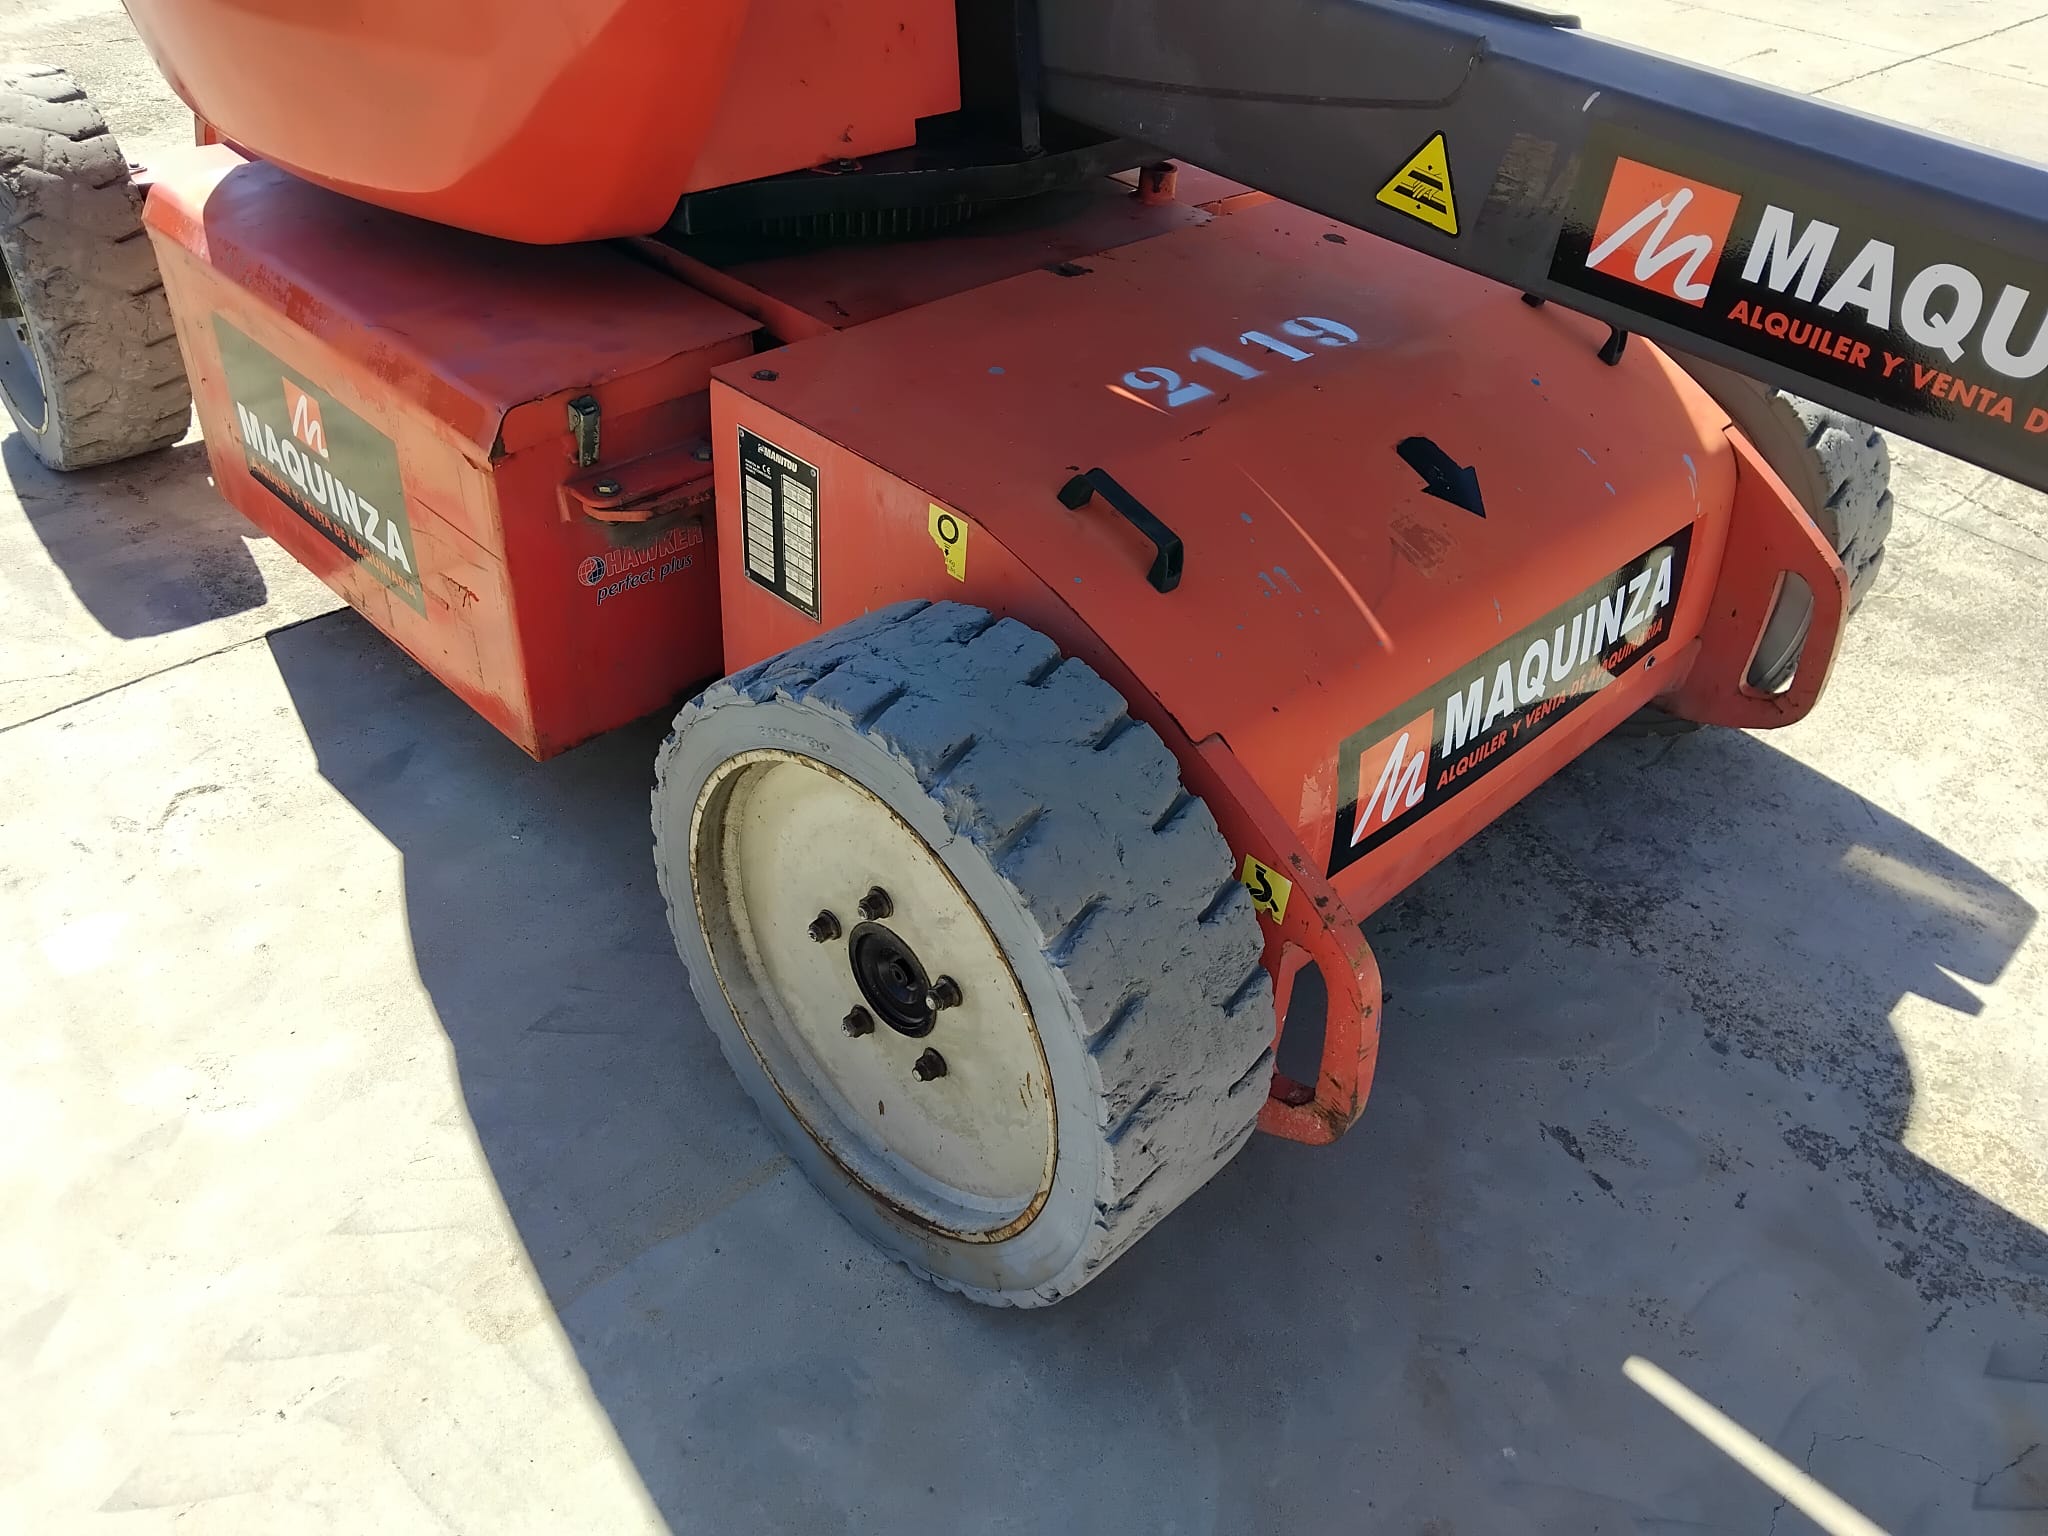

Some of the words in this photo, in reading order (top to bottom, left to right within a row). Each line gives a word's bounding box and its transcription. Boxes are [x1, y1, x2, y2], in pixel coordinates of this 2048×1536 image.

[1122, 315, 1360, 408] 2119
[1728, 300, 1872, 368] ALQUILER
[1882, 351, 1905, 378] Y
[1913, 363, 2014, 424] VENTA
[236, 400, 413, 575] MAQUINZA
[763, 446, 798, 473] MANITOU
[596, 567, 656, 606] perfect
[659, 554, 693, 582] plus
[604, 526, 704, 577] HAWKER
[1441, 554, 1672, 760] MAQUINZA
[1436, 729, 1508, 792] ALQUILER
[1511, 719, 1522, 738] Y
[1525, 690, 1567, 730] VENTA
[1570, 674, 1587, 699] DE
